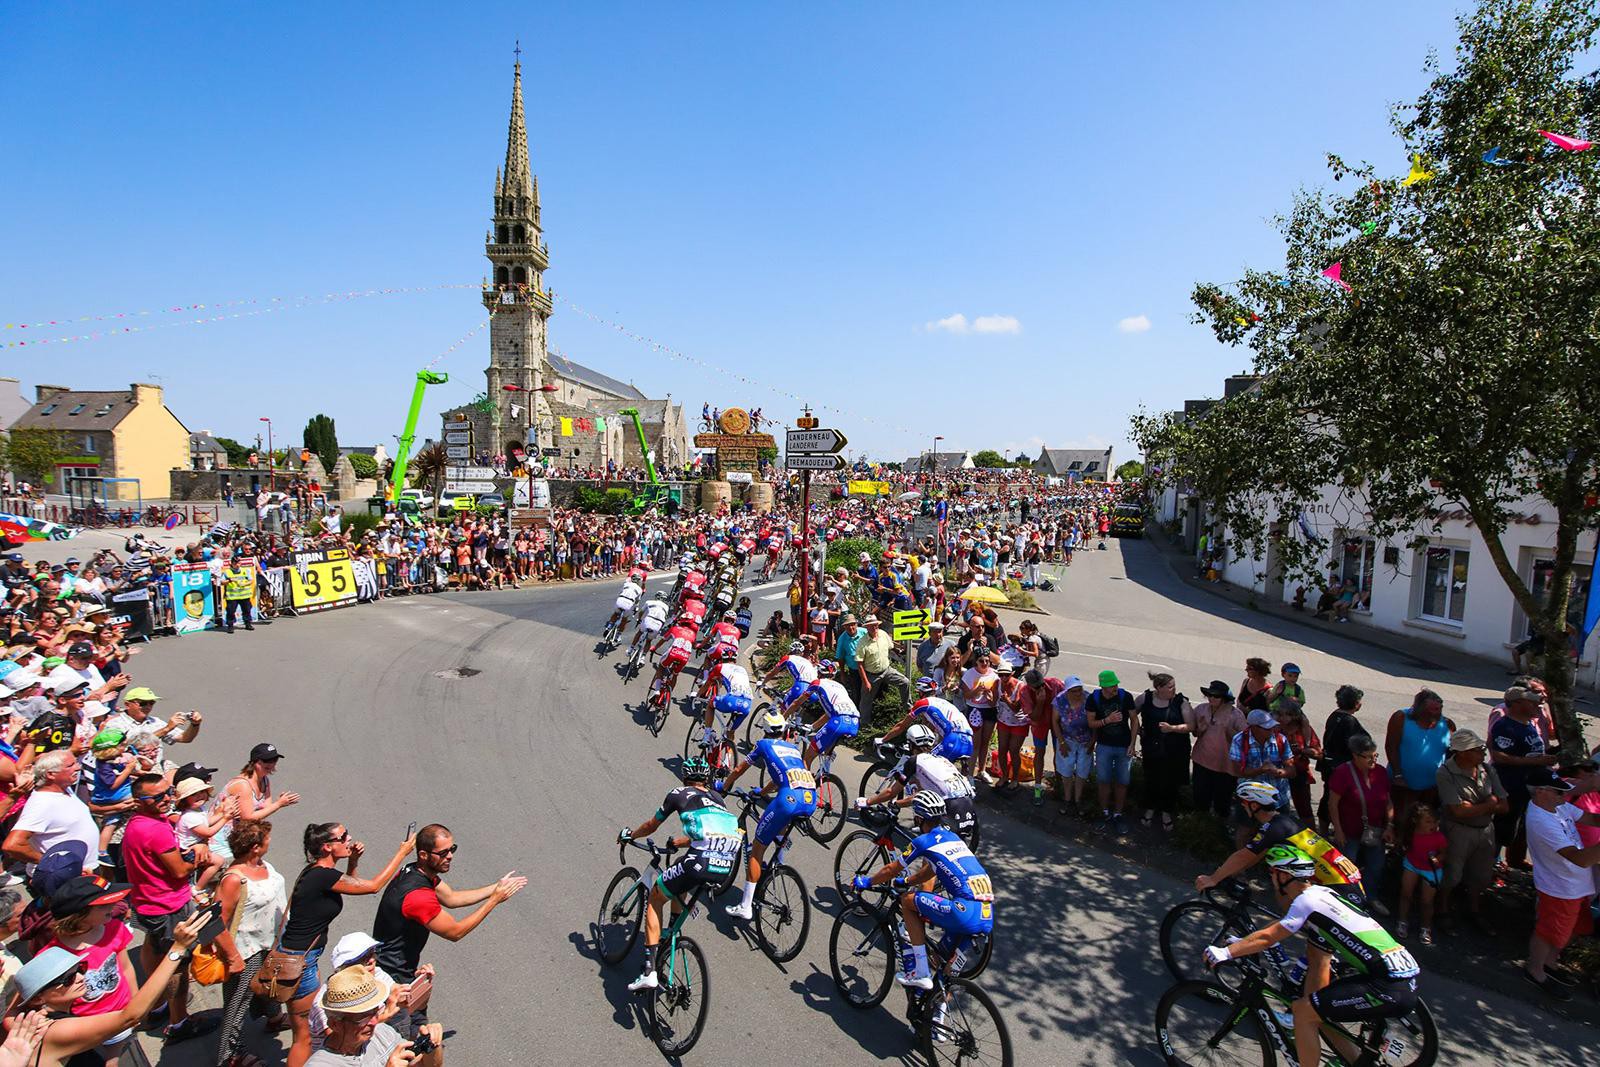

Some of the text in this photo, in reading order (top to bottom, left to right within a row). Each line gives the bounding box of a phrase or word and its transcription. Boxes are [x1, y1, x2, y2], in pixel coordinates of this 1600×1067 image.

[789, 433, 830, 441] LANDERNEAU
[295, 552, 323, 562] RIBIN
[181, 573, 203, 587] 18
[708, 837, 727, 851] 113
[709, 857, 731, 867] BORA
[936, 861, 953, 876] QUICK
[662, 863, 685, 882] BORA
[971, 878, 991, 895] 101
[920, 896, 939, 911] QUICK
[1330, 926, 1372, 960] Deloitte
[954, 955, 965, 968] 101
[1385, 951, 1412, 972] 138
[1389, 1040, 1405, 1058] 138
